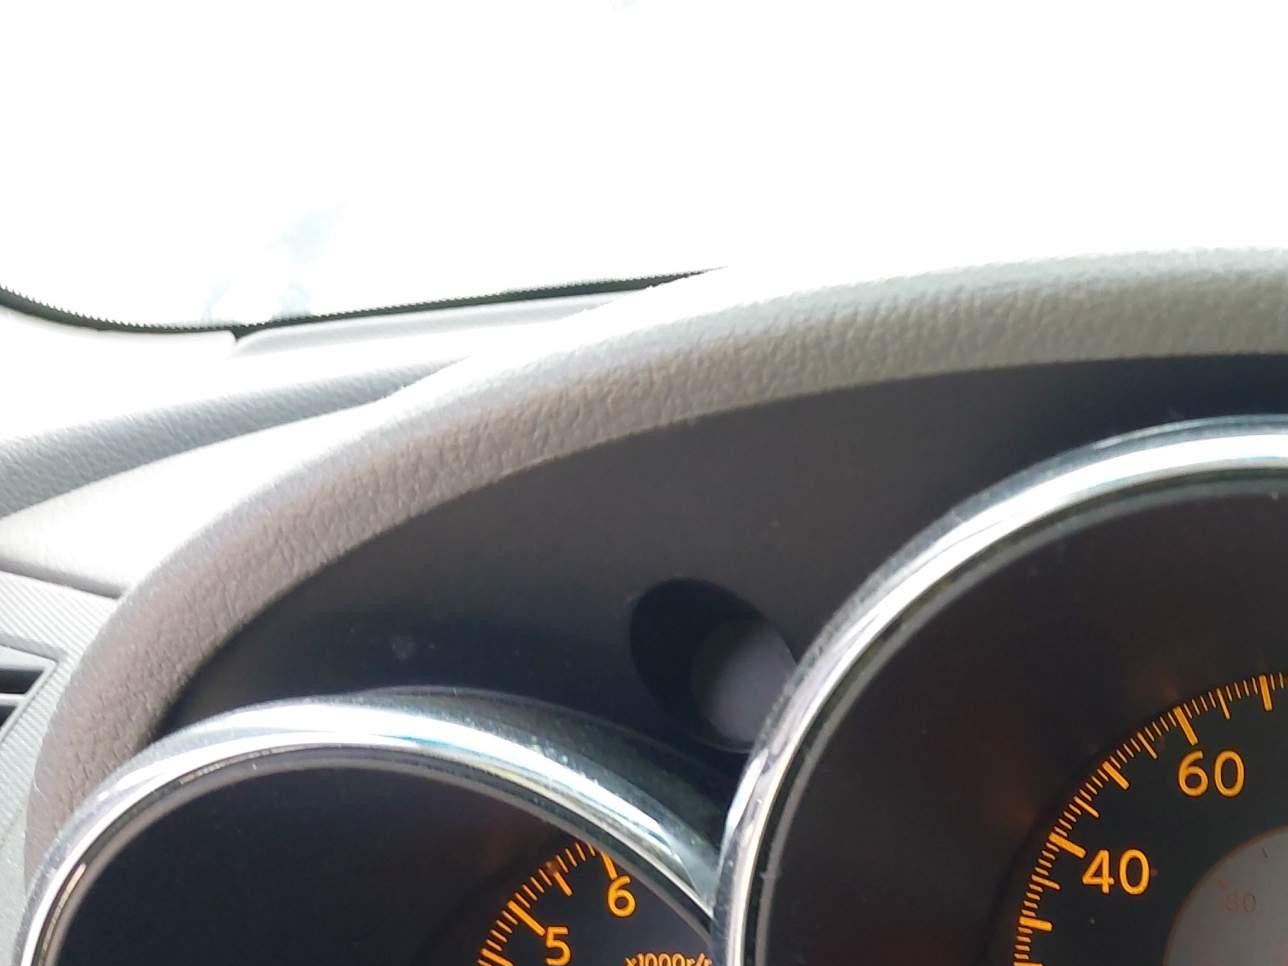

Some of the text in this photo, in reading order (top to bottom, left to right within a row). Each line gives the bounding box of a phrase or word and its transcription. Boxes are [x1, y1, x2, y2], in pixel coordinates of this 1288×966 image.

[1177, 750, 1245, 797] 60
[1081, 849, 1150, 895] 40
[607, 874, 637, 917] 6
[544, 926, 572, 966] 5
